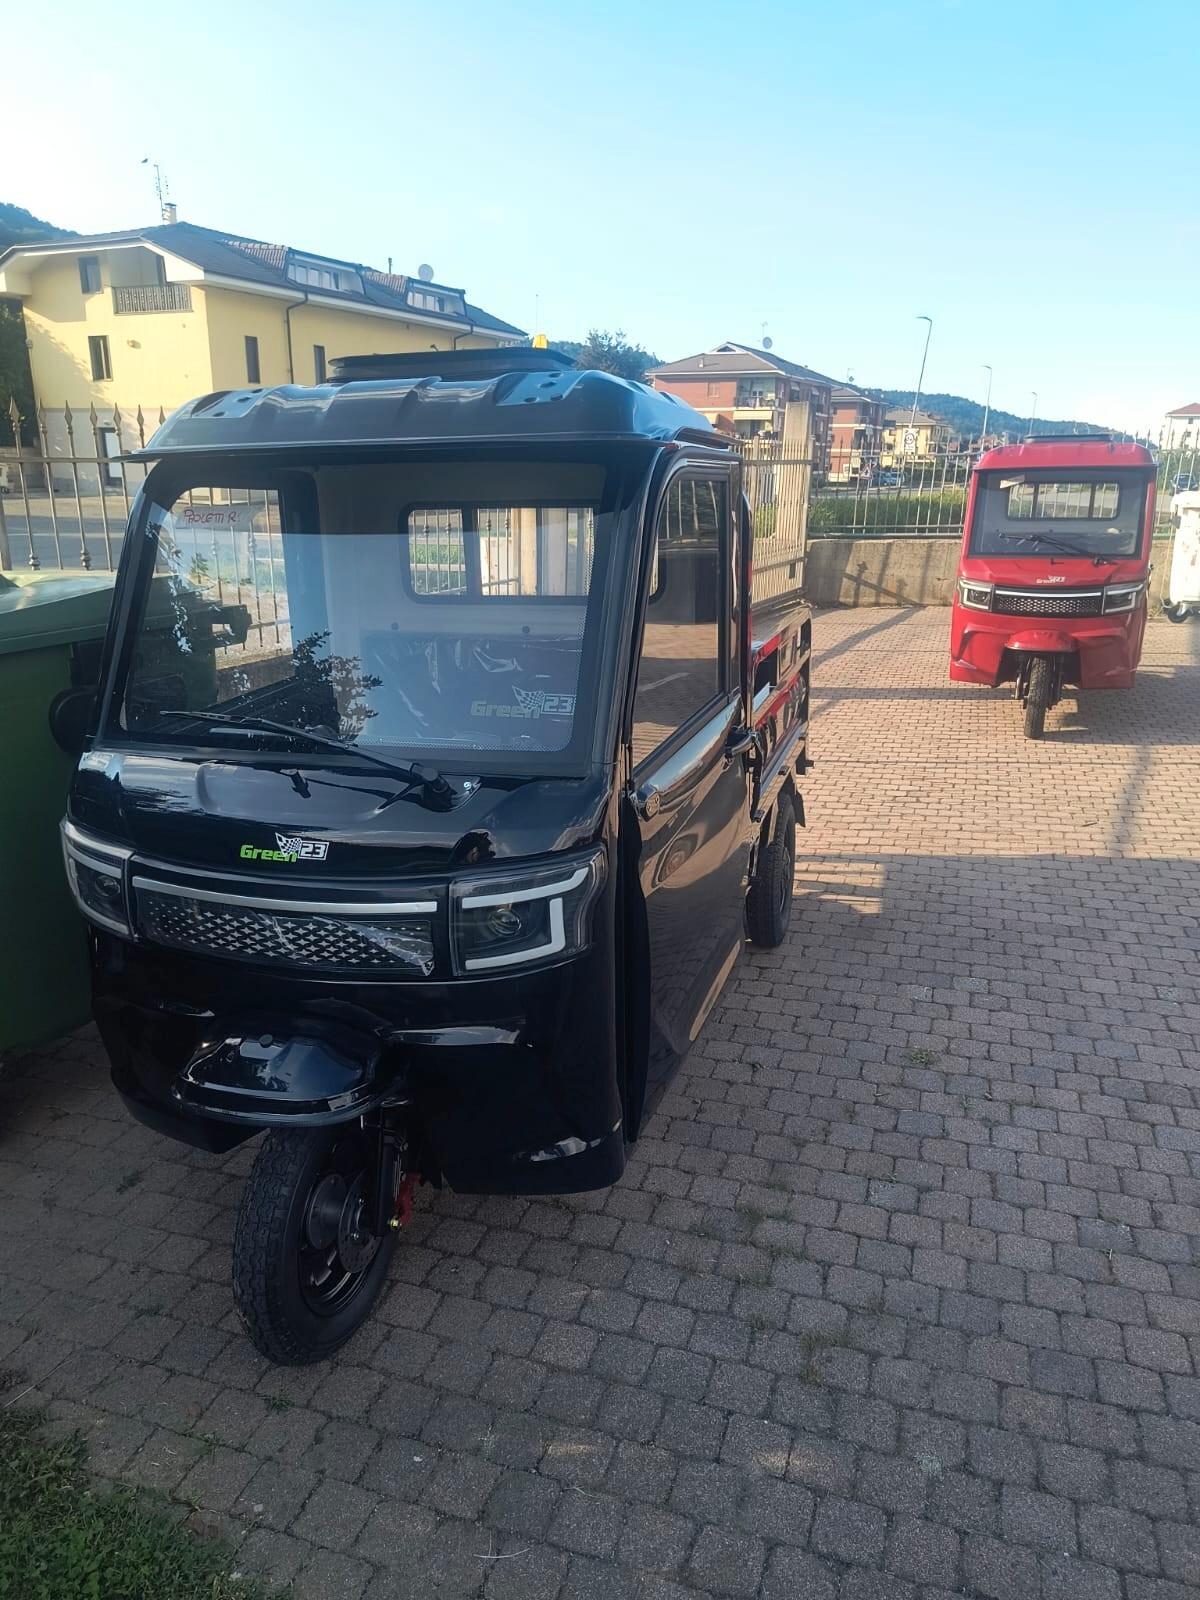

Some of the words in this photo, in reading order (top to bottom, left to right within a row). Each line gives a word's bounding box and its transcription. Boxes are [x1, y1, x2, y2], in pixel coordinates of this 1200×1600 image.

[543, 695, 574, 713] 23
[240, 844, 297, 863] Green
[300, 842, 327, 859] 23
